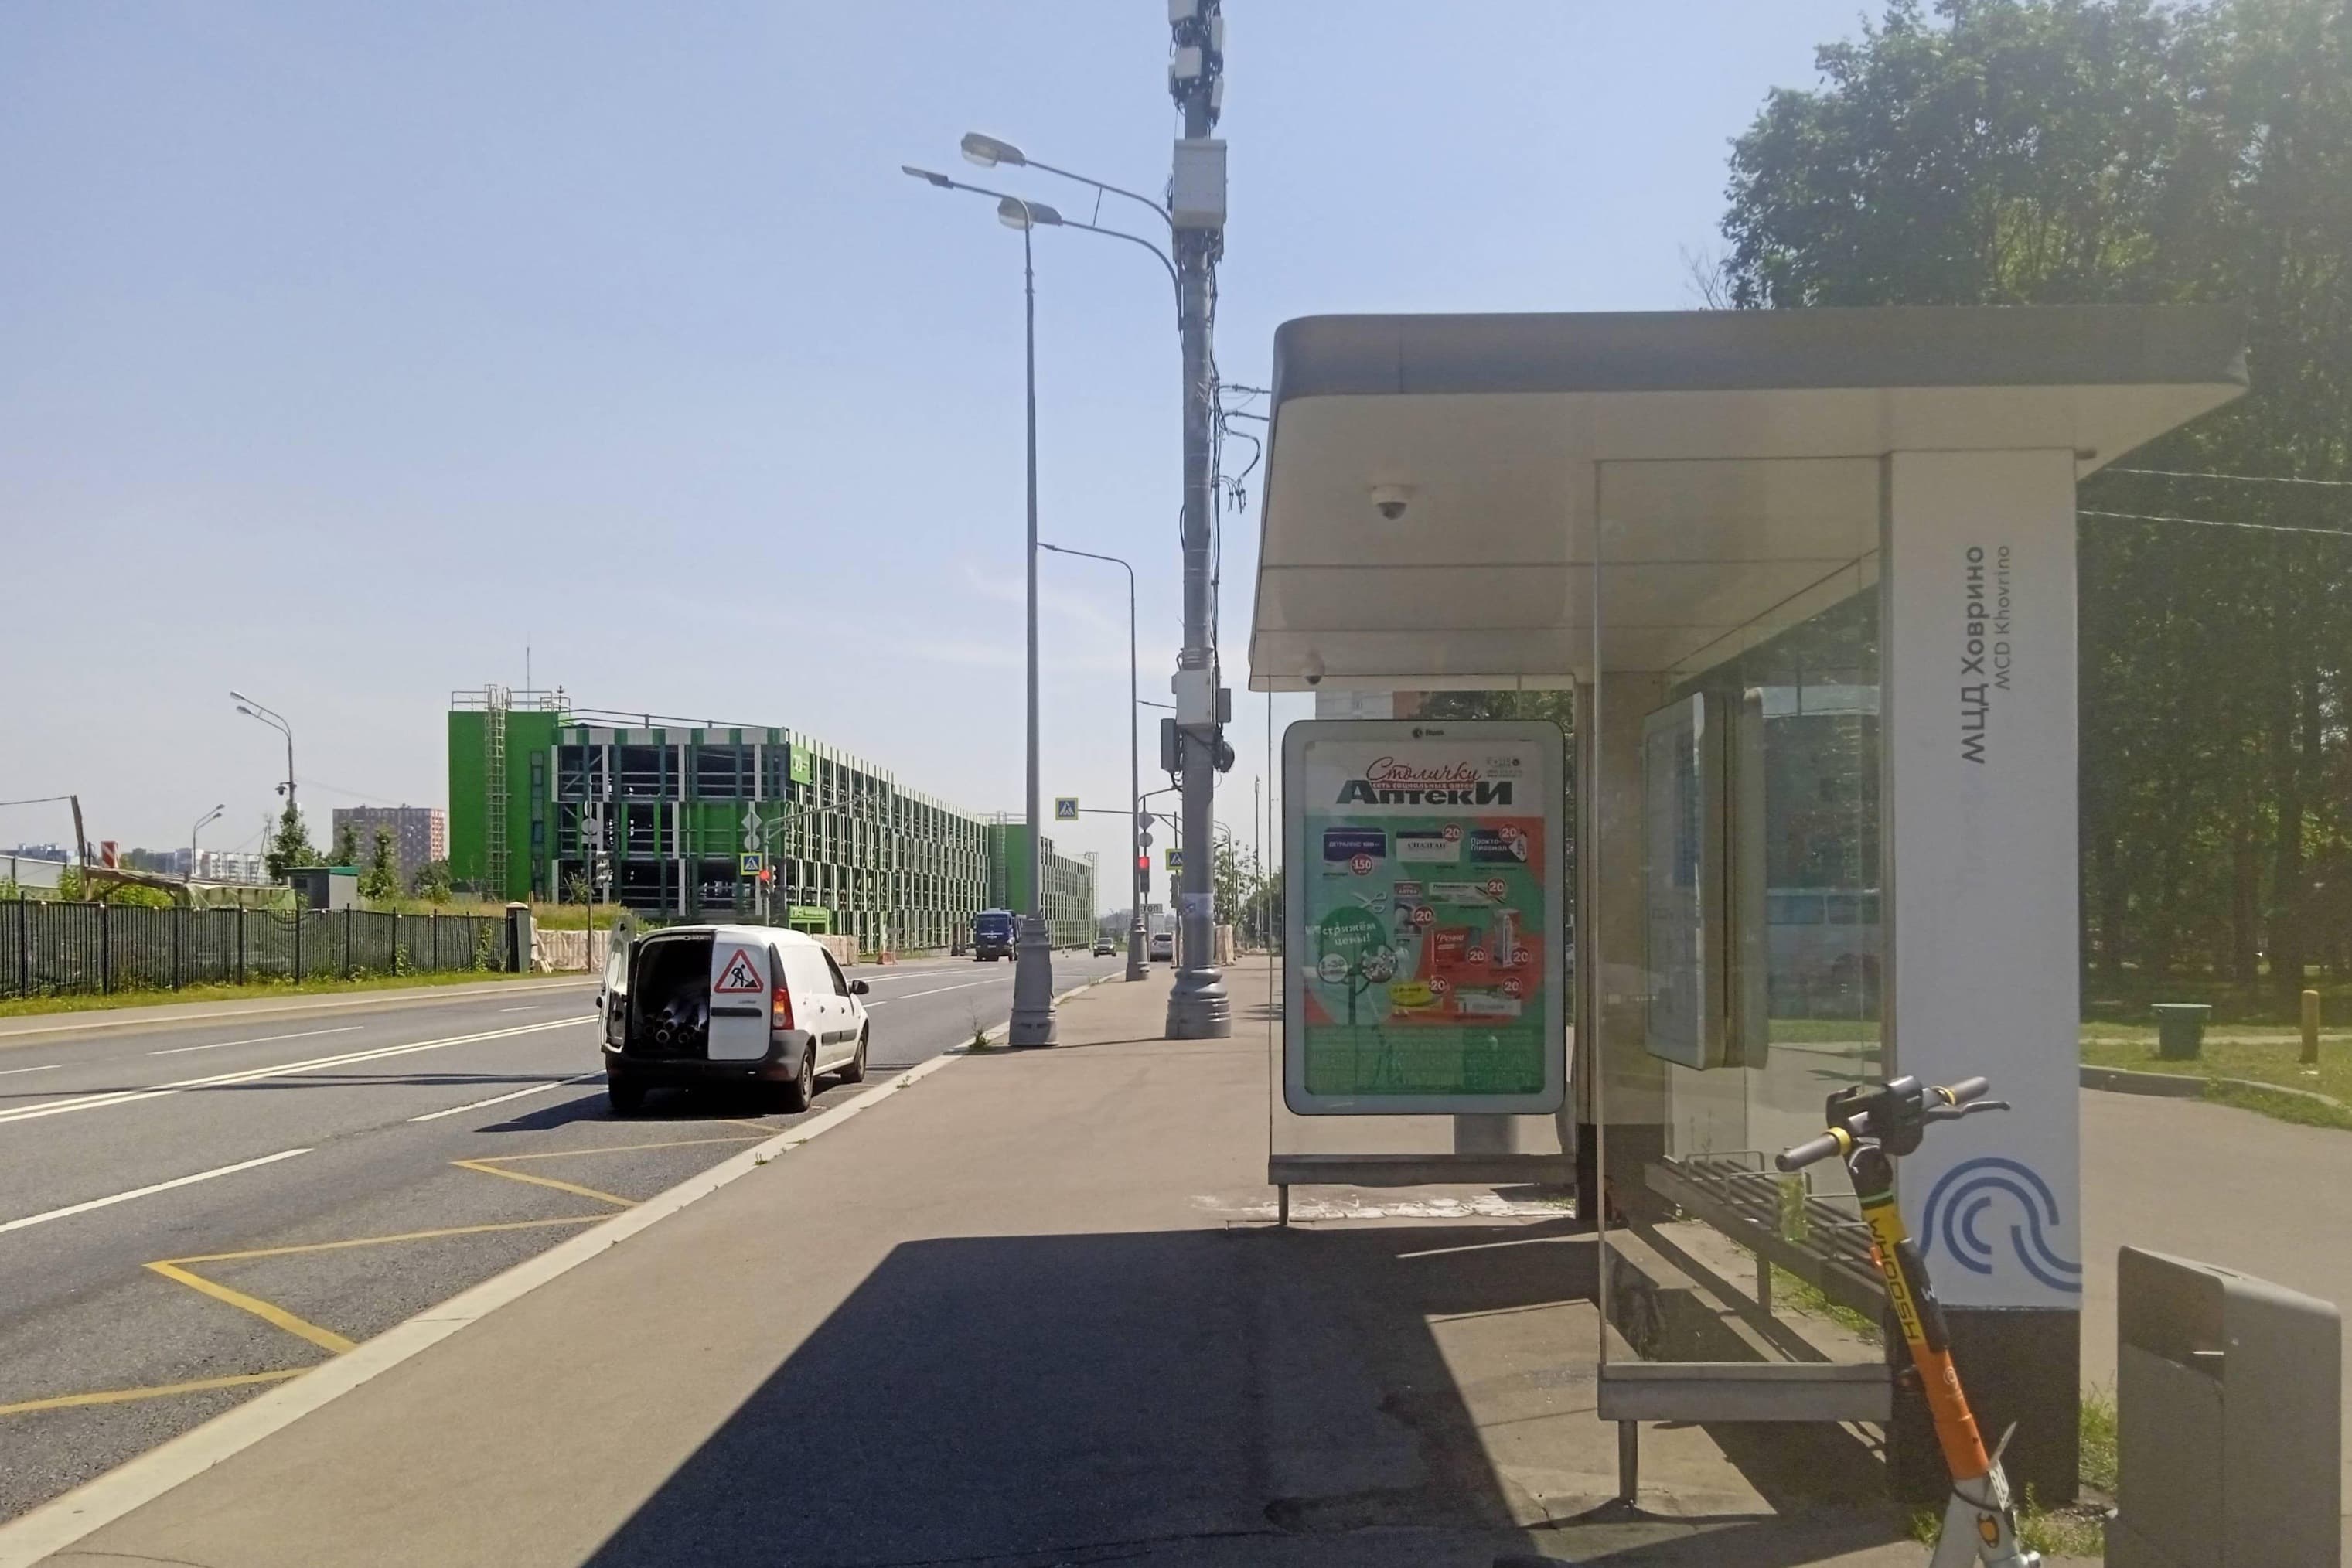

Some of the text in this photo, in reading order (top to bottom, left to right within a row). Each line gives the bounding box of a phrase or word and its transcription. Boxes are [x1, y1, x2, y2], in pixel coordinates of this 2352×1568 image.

[1993, 545, 2011, 690] MCD Khovrino
[1961, 546, 1989, 765] МЦД Ховрино
[1366, 756, 1481, 781] Столички
[1444, 827, 1461, 838] 20
[1502, 827, 1517, 838] 20
[1489, 882, 1504, 892] 20
[1415, 911, 1433, 922] 20
[1468, 951, 1485, 962] 20
[1512, 951, 1529, 963] 20
[1430, 980, 1446, 991] 20
[1504, 981, 1520, 992] 20
[1868, 1217, 1921, 1340] WHOOSH
